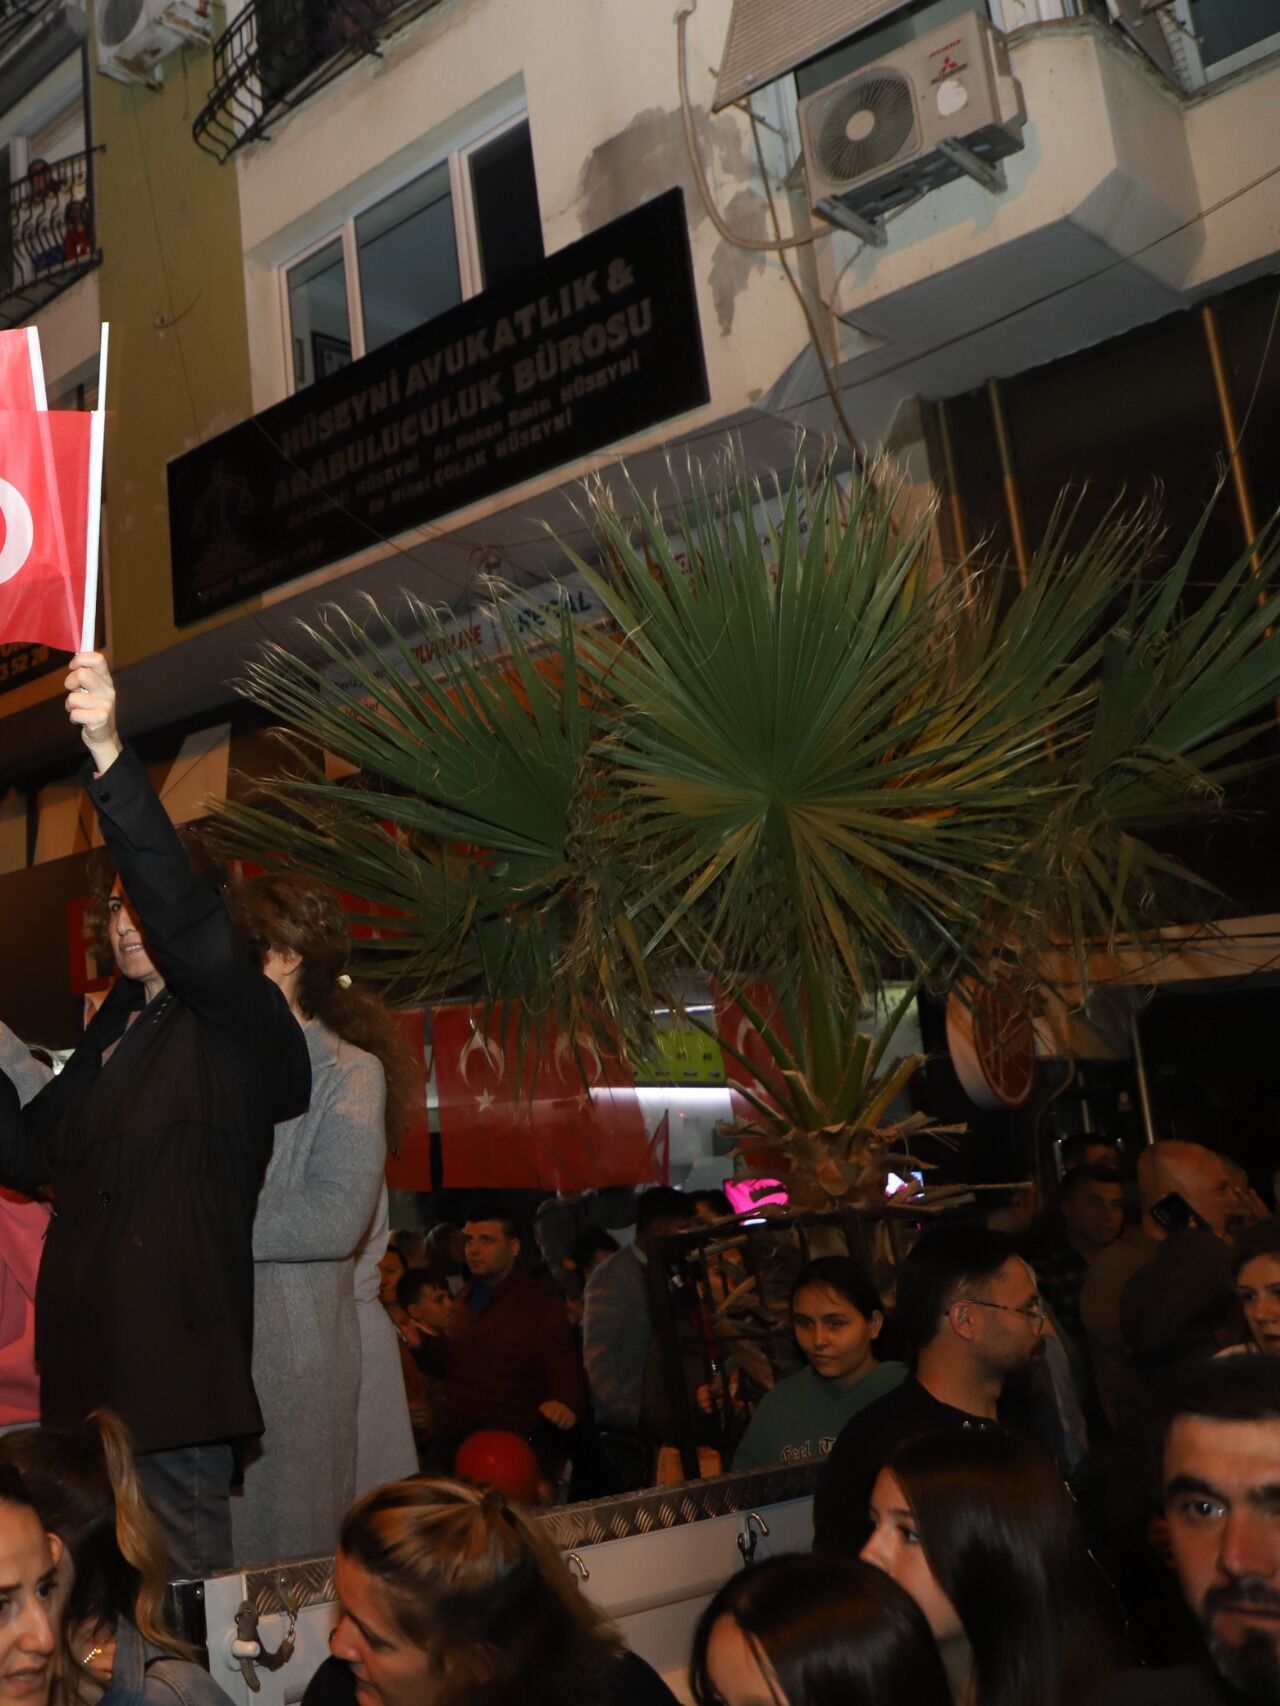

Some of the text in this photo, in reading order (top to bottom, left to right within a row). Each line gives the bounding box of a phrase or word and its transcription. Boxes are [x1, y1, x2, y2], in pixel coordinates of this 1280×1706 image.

[272, 297, 654, 511] ARABULUCULUK BÜROSU
[405, 270, 601, 397] AVUKATLIK
[606, 256, 635, 294] &
